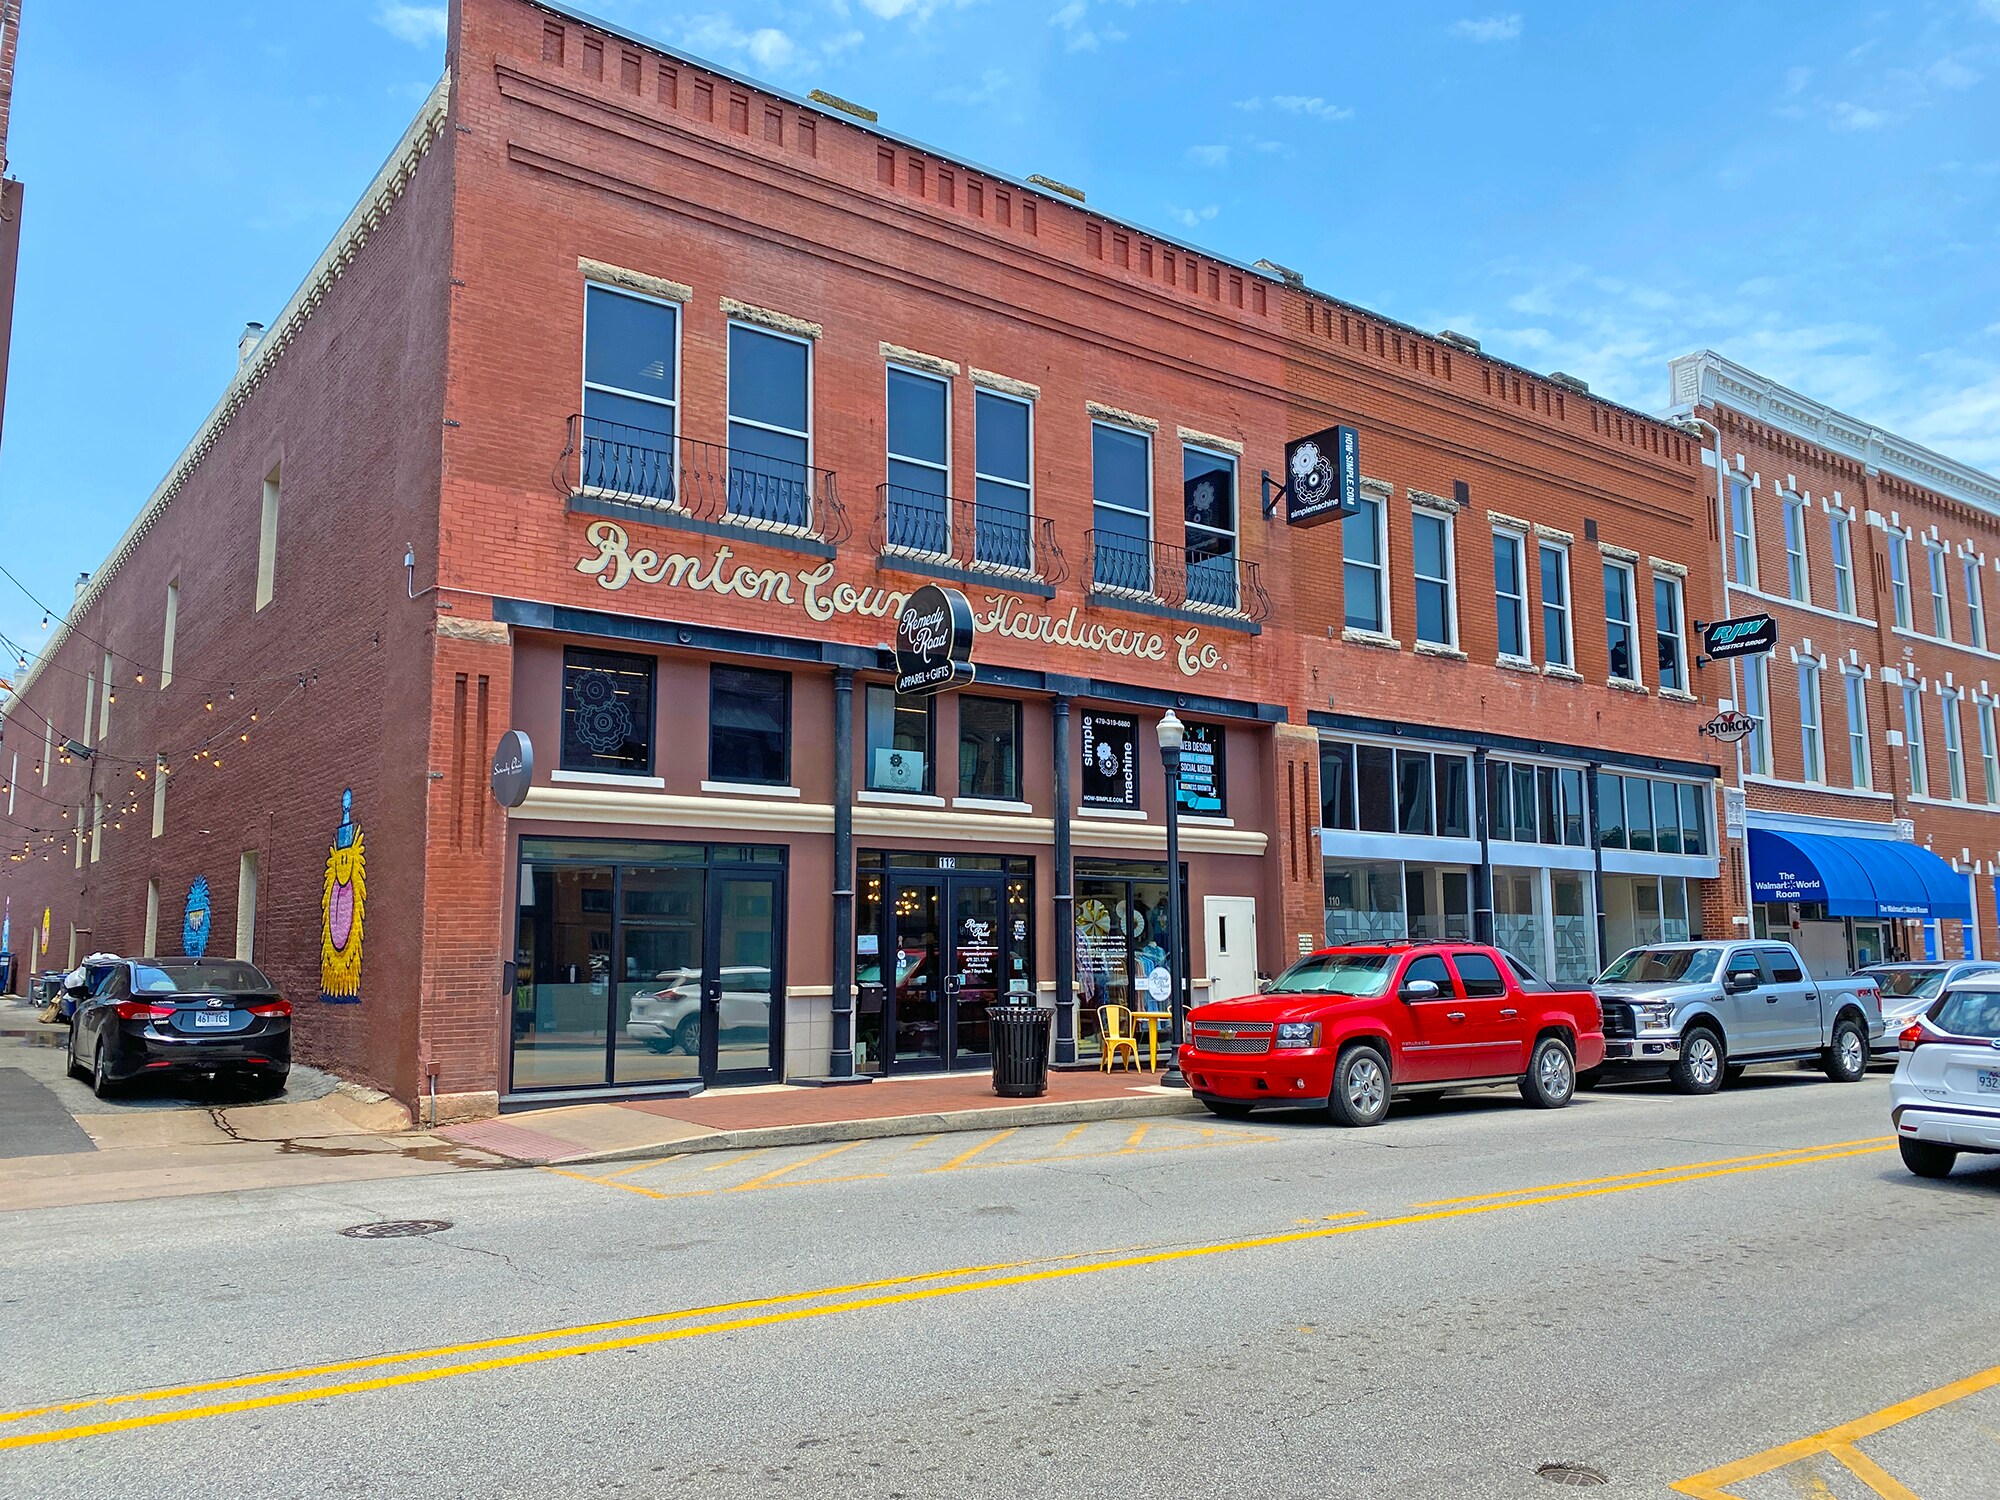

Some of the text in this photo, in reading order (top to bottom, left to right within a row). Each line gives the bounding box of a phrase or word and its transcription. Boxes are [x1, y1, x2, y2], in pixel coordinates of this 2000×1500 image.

[1344, 432, 1355, 506] HOW-SIMPLE.COM
[1290, 498, 1339, 518] simplemachine
[574, 521, 796, 606] Benton
[973, 593, 1167, 661] Hardware
[1173, 627, 1229, 677] Co.
[900, 606, 945, 644] Remedy
[1710, 618, 1768, 644] RJW
[913, 627, 949, 664] Road
[1712, 638, 1768, 652] LOGISTICS GROUP
[900, 671, 926, 689] APPAREL
[930, 665, 949, 680] GIFTS
[1708, 719, 1750, 734] STORCK
[1082, 716, 1094, 766] simple
[1192, 742, 1212, 753] DESIGN
[1122, 742, 1134, 804] machine
[1180, 762, 1212, 774] SOCIAL MEDIA
[1083, 794, 1124, 802] HOW-SIMPLE.COM
[940, 858, 954, 868] 112
[1755, 880, 1820, 890] Walmart World
[1328, 896, 1340, 906] 110
[1979, 1076, 1998, 1088] 932
